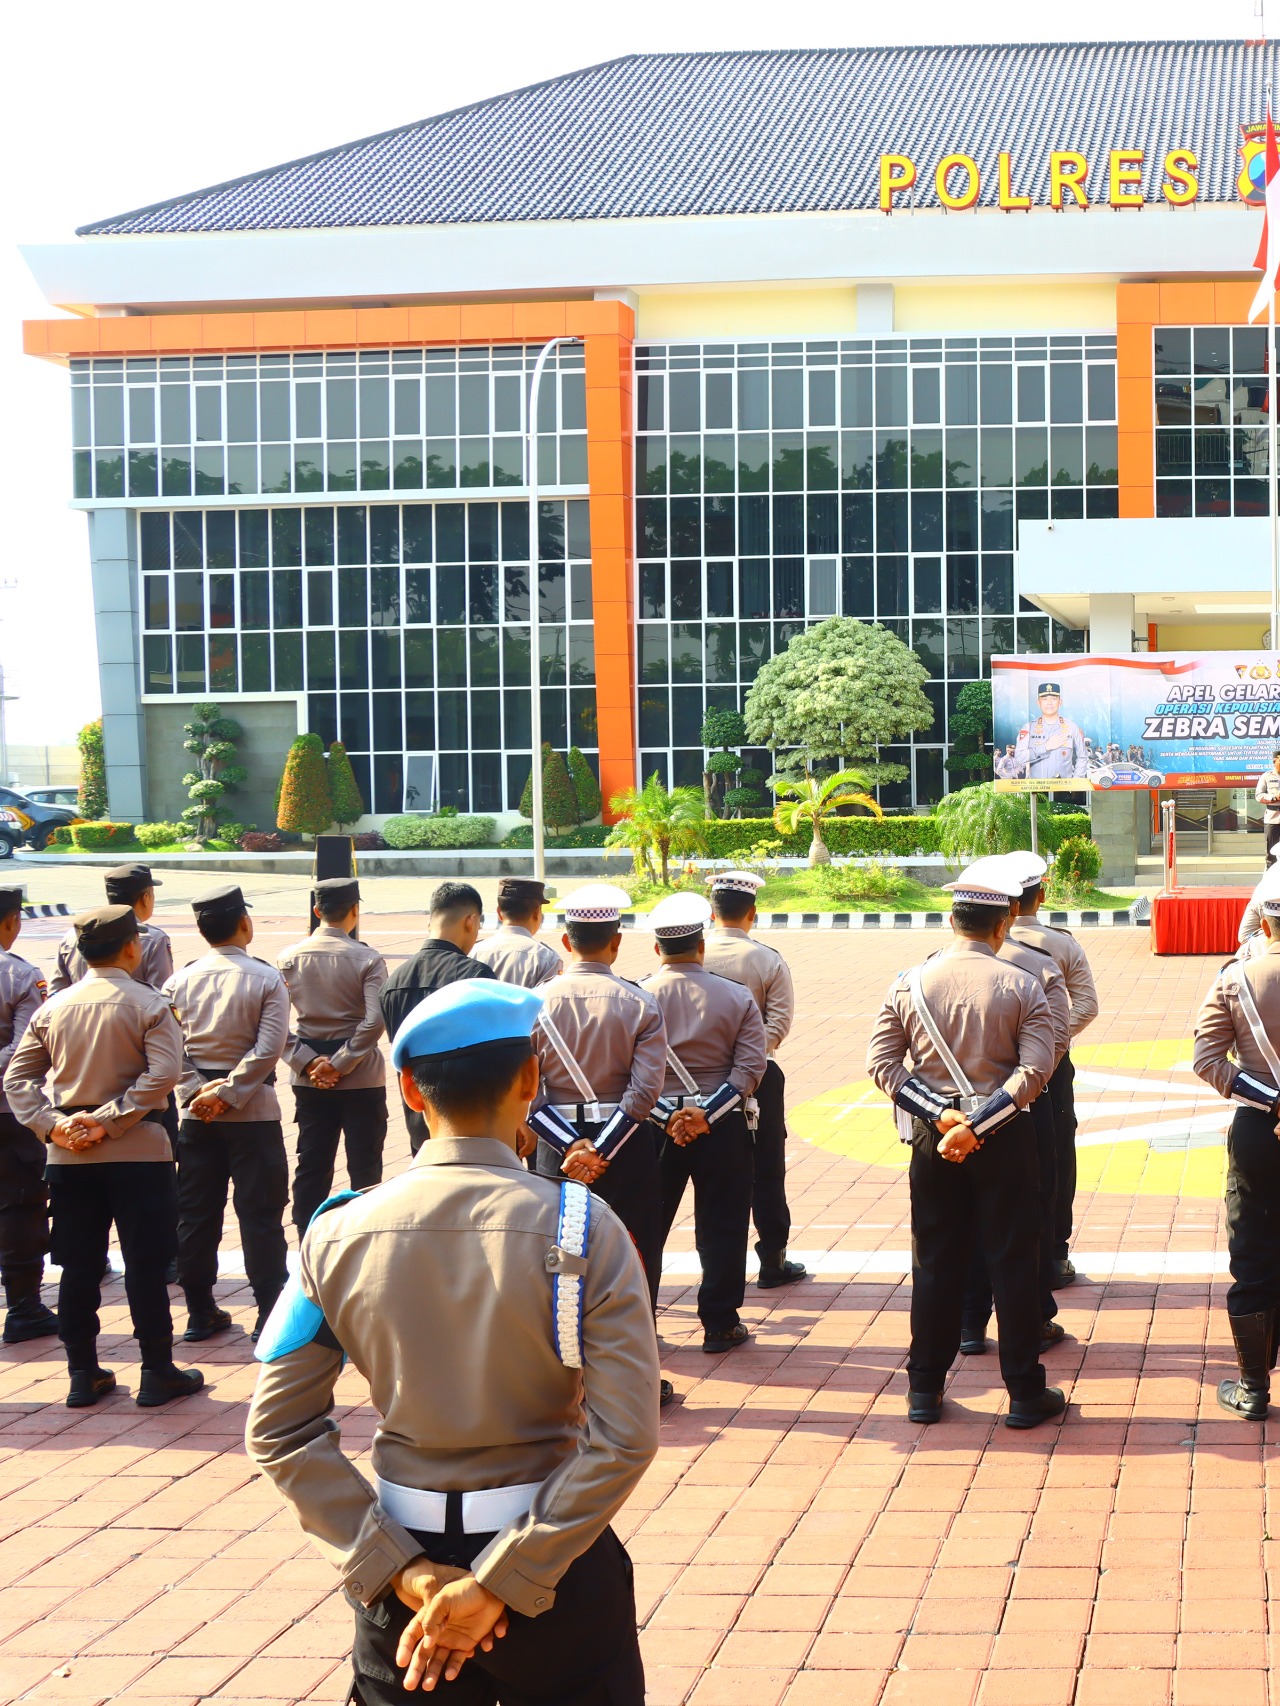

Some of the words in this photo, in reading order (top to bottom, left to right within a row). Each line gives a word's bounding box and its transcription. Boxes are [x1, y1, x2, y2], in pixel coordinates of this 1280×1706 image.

[1246, 124, 1267, 134] JAWA
[879, 148, 1199, 212] POLRES
[1166, 685, 1216, 702] APEL
[1154, 703, 1213, 716] OPERASI
[1142, 715, 1230, 741] ZEBRA
